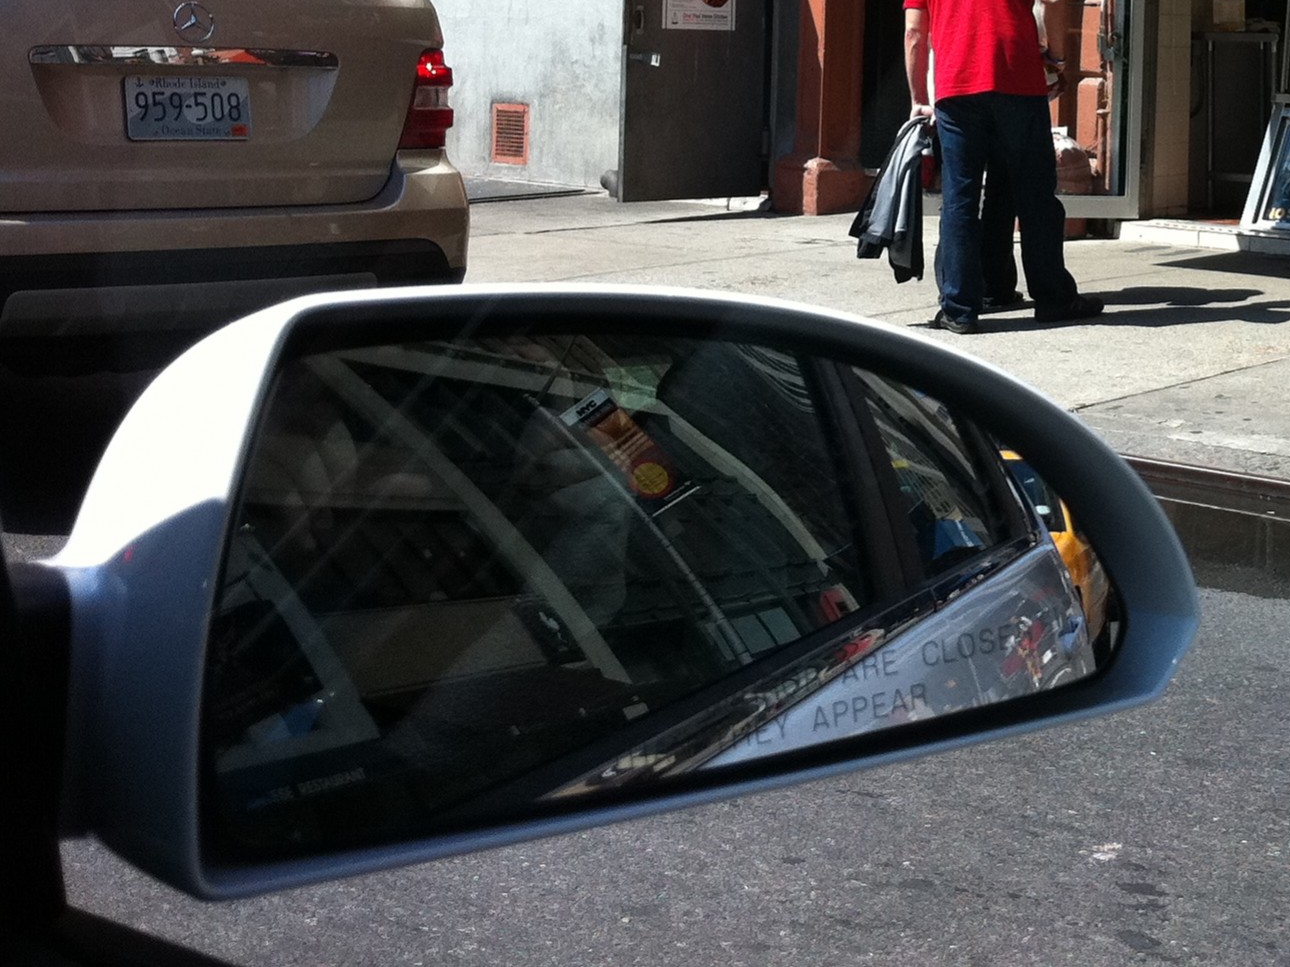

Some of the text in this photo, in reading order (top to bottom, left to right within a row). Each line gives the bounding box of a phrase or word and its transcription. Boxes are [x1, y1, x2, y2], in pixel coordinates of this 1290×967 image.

[155, 77, 220, 89] Rhode Island
[134, 92, 241, 122] 959-508
[841, 649, 899, 684] ARE
[811, 682, 928, 731] APPEAR
